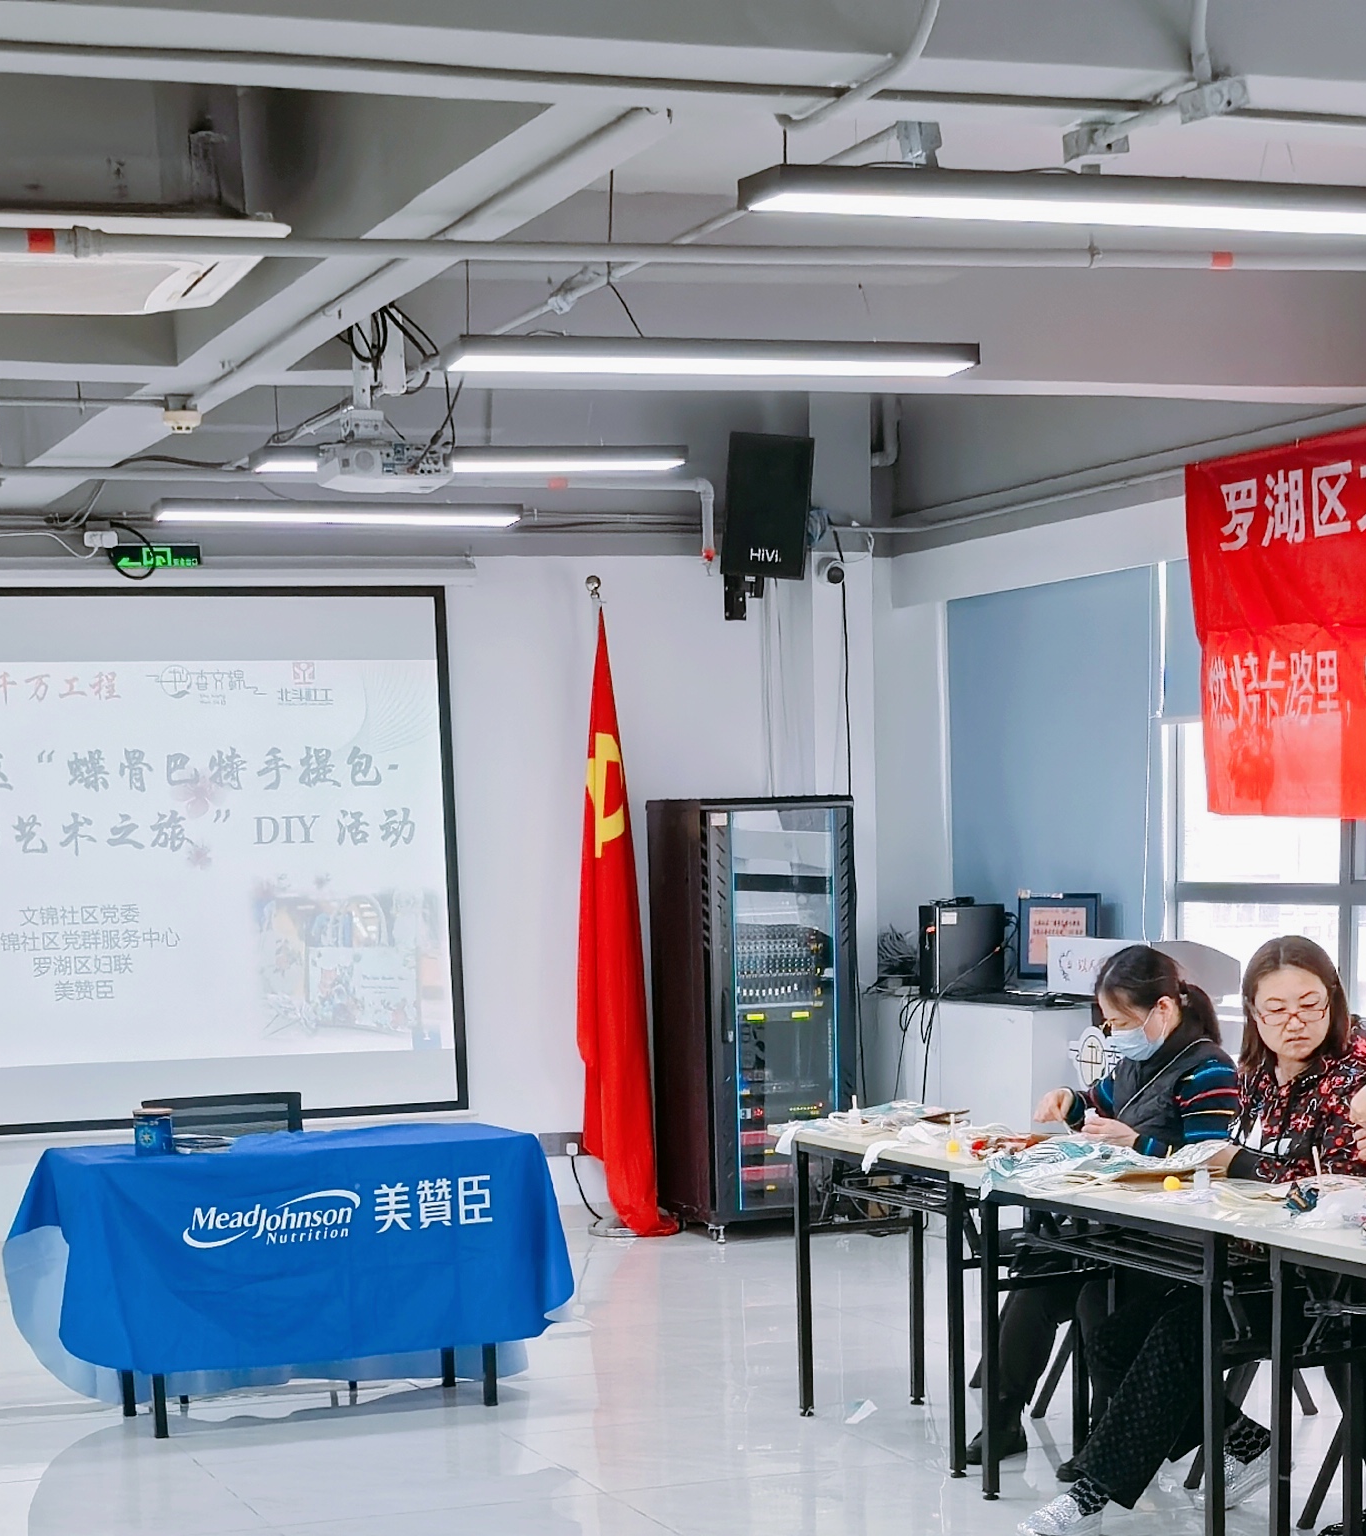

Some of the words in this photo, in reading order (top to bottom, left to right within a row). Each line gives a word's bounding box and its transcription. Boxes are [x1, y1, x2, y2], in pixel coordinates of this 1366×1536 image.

[253, 815, 320, 845] DIY
[336, 807, 416, 848] 活动
[19, 903, 141, 927] 文锦社区党委
[32, 953, 133, 977] 罗湖区妇联
[54, 979, 115, 1001] 美赞臣
[266, 1227, 349, 1245] Nutrition
